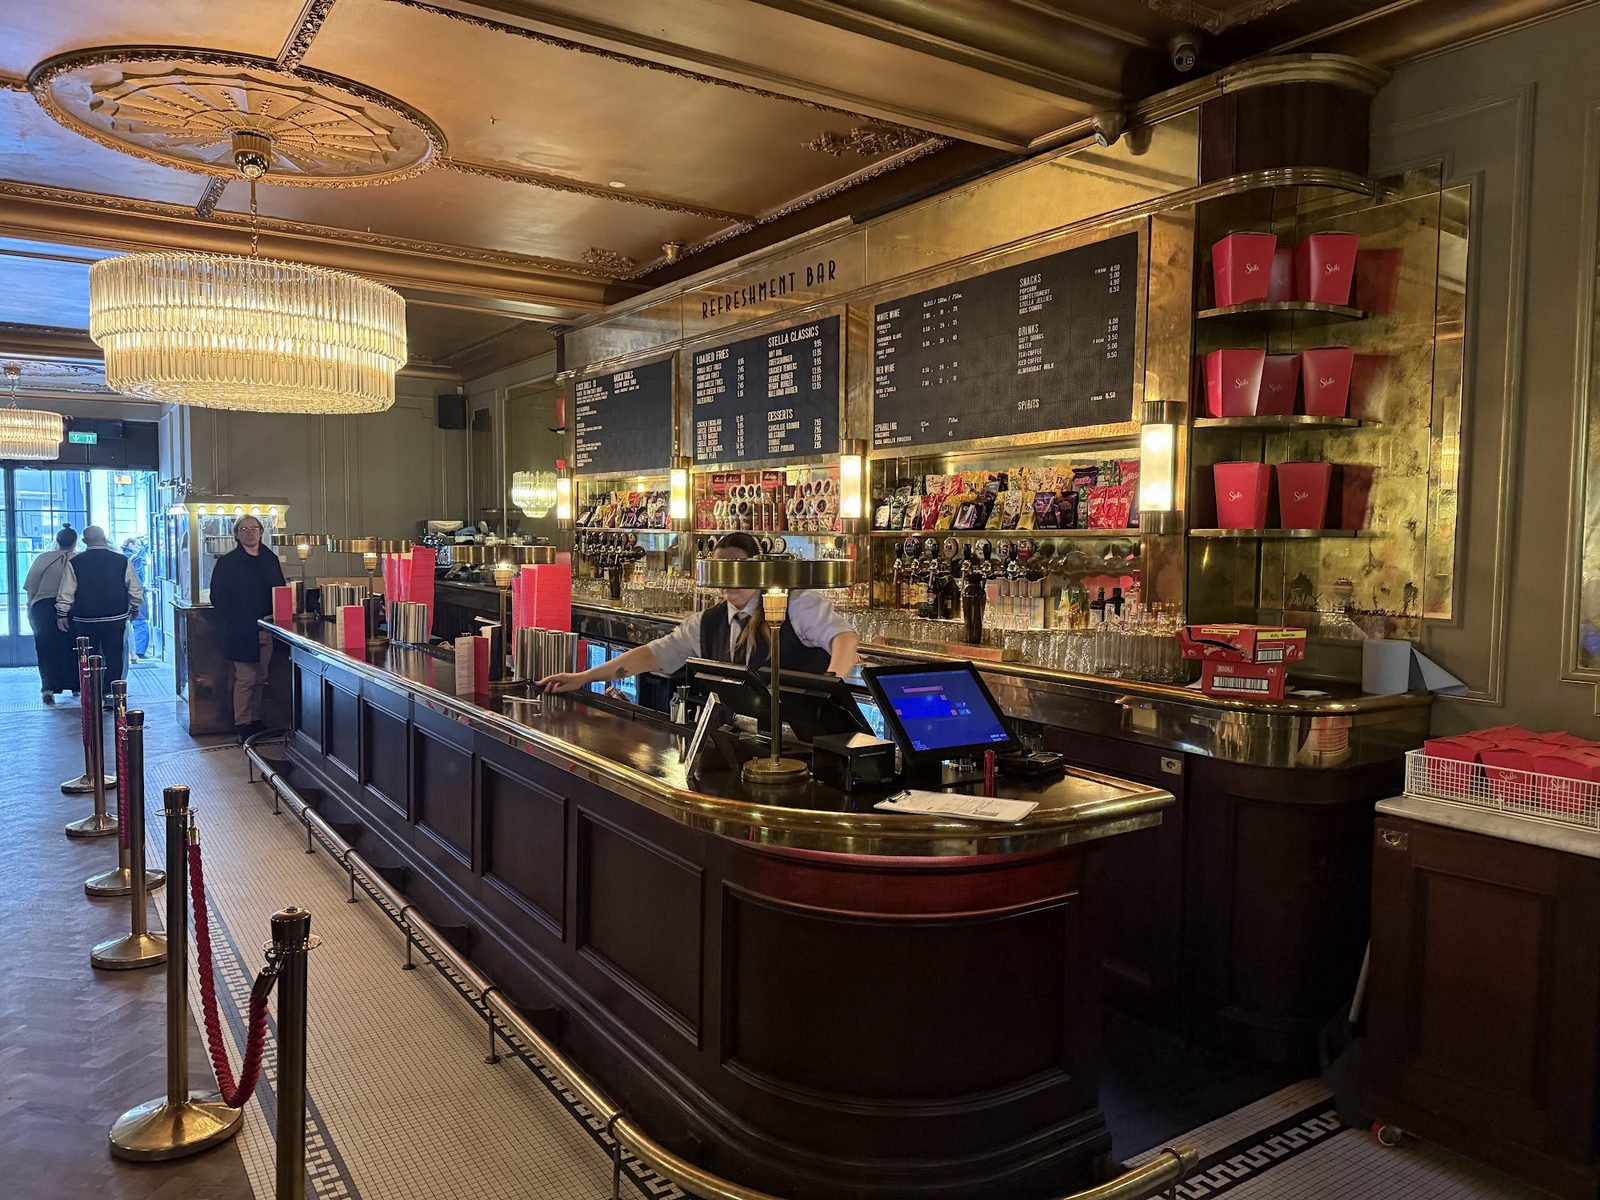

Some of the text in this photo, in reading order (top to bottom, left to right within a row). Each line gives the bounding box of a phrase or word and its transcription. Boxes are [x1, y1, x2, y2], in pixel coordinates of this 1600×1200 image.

[1020, 285, 1037, 294] POPCORN
[1110, 264, 1120, 272] 4.50
[1020, 274, 1041, 287] SNACKS
[703, 260, 835, 319] REFRESHMENT BAR
[1036, 295, 1052, 303] JELLIES
[1019, 324, 1039, 336] DRINKS
[768, 326, 819, 348] STELLA CLASSICS
[697, 349, 729, 365] LOADED FRIES
[885, 363, 895, 372] WINE
[1018, 399, 1039, 411] SPIRITS
[768, 409, 793, 422] DESSERTS
[875, 422, 897, 432] SPARKLING
[1500, 772, 1517, 781] Stella
